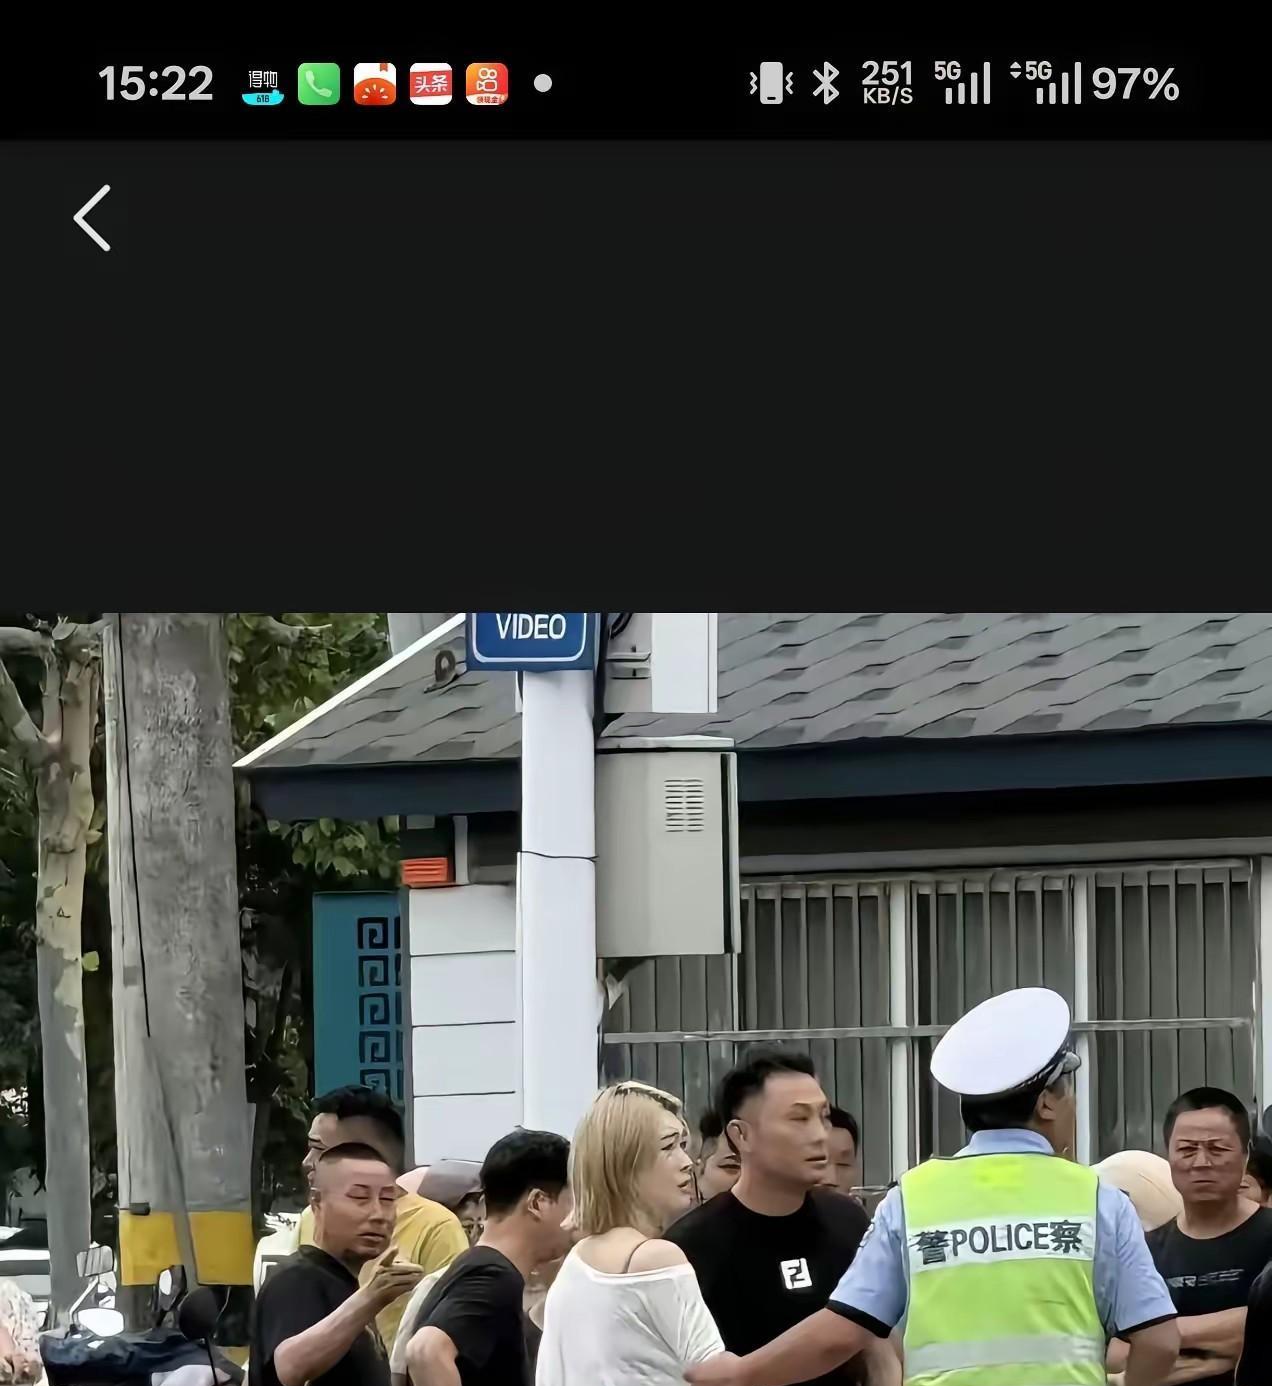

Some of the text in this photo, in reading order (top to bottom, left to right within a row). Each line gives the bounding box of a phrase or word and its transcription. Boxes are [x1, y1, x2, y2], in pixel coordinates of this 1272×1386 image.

[248, 70, 278, 88] 得物
[861, 60, 912, 86] 251
[934, 60, 962, 81] 5G
[1025, 60, 1053, 81] 5G
[98, 65, 213, 101] 15:22
[414, 74, 448, 93] 头条
[1092, 66, 1180, 101] 97%
[863, 87, 914, 106] KB/S
[496, 613, 567, 640] VIDEO
